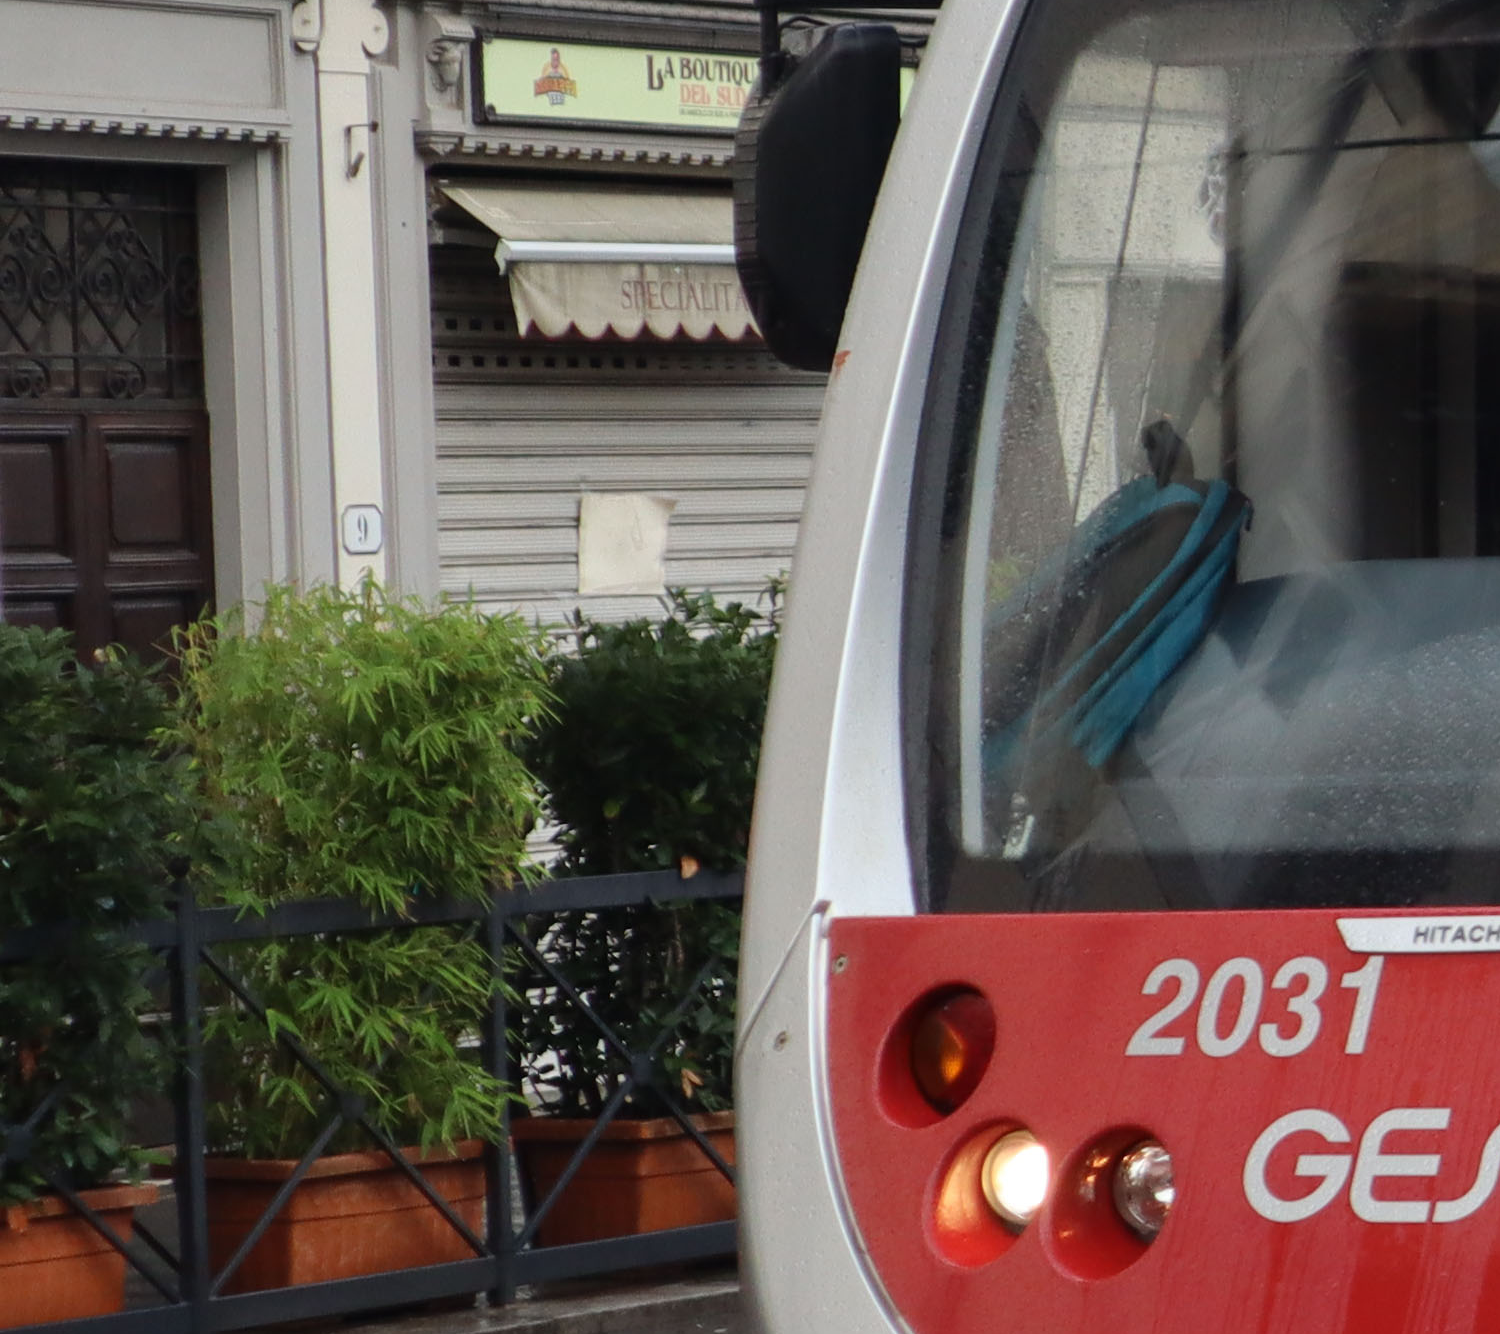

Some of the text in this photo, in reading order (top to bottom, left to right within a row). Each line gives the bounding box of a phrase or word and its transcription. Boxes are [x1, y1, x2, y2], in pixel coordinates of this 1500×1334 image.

[679, 56, 755, 87] BOUTIQU
[679, 83, 711, 105] DEL
[357, 514, 368, 544] 9
[1124, 955, 1386, 1058] 2031
